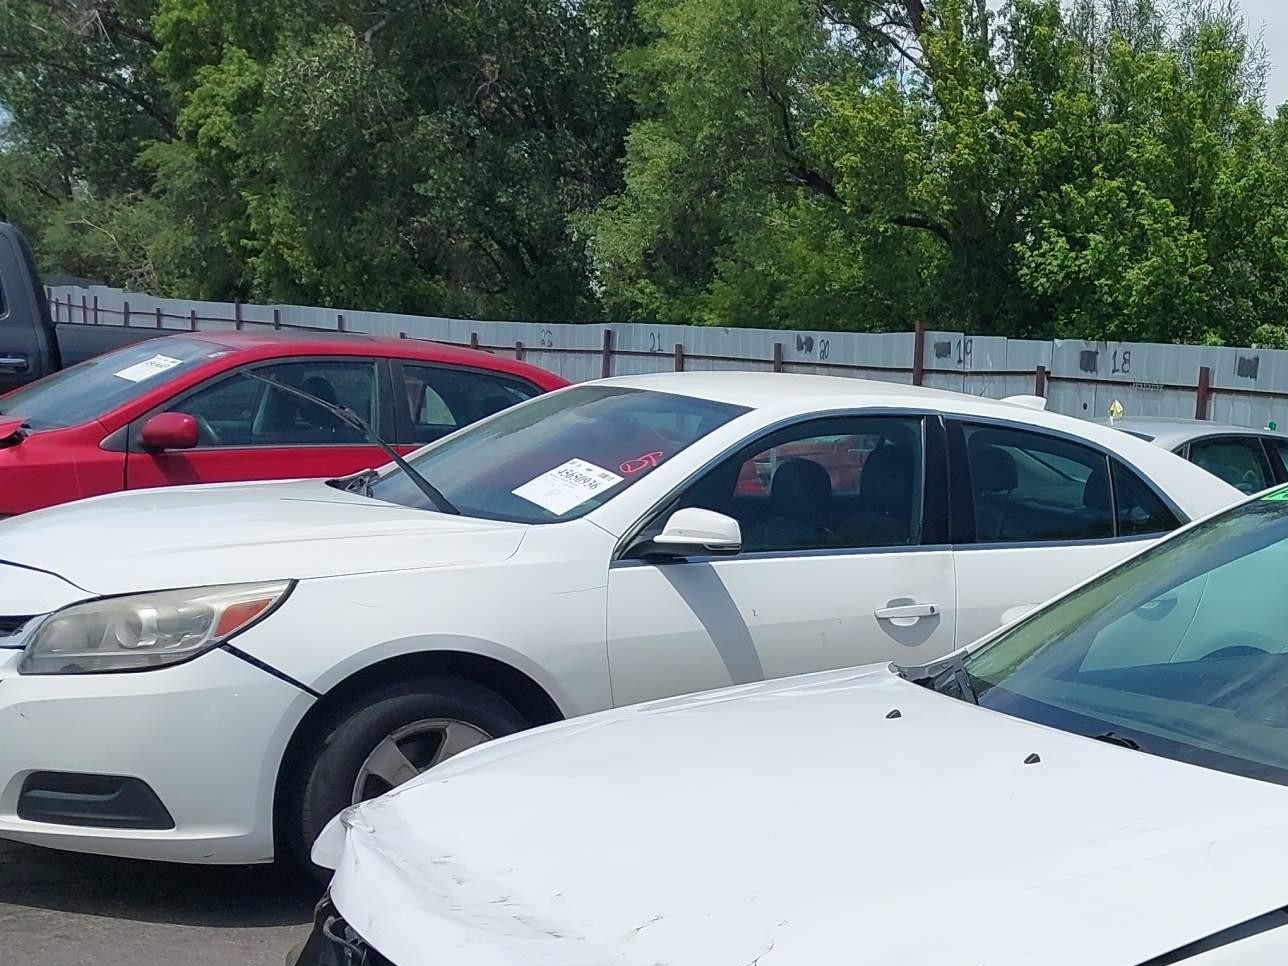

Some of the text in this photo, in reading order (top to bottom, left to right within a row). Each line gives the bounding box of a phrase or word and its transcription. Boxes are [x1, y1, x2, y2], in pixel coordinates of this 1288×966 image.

[819, 338, 830, 361] 20
[955, 338, 973, 368] 19
[1111, 349, 1131, 374] 18
